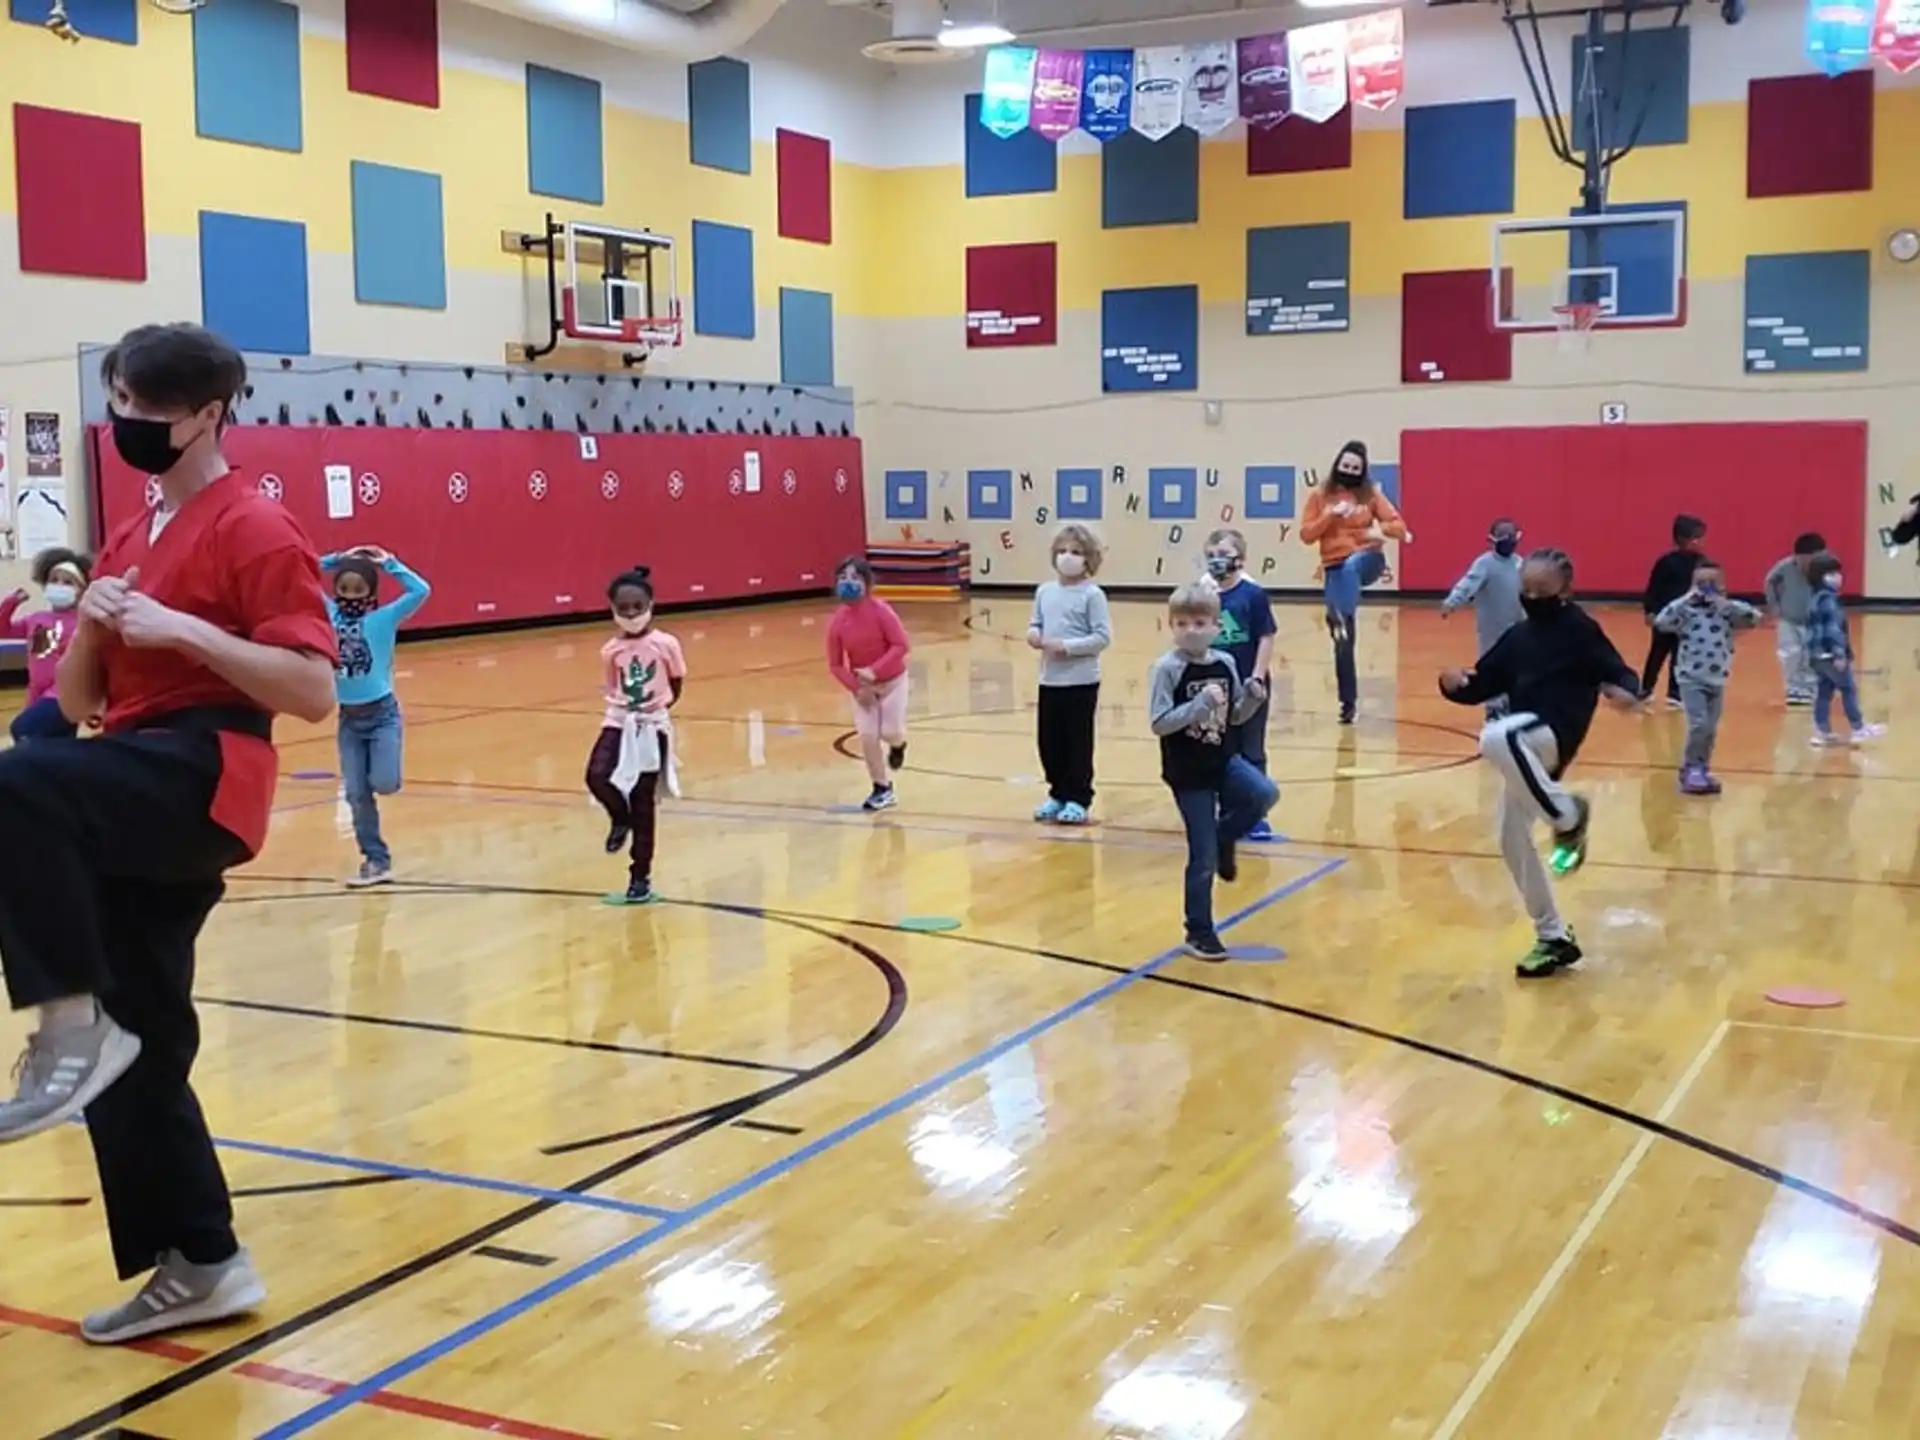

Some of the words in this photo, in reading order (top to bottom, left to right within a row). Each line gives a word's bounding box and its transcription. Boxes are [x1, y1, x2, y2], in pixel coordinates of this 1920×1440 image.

[1112, 465, 1125, 484] R
[1206, 468, 1219, 487] U
[1304, 468, 1318, 487] U
[1879, 482, 1895, 504] N
[1036, 507, 1049, 524] S
[1000, 531, 1015, 550] E
[1280, 523, 1290, 542] Y
[980, 558, 991, 575] J
[1262, 557, 1276, 575] P
